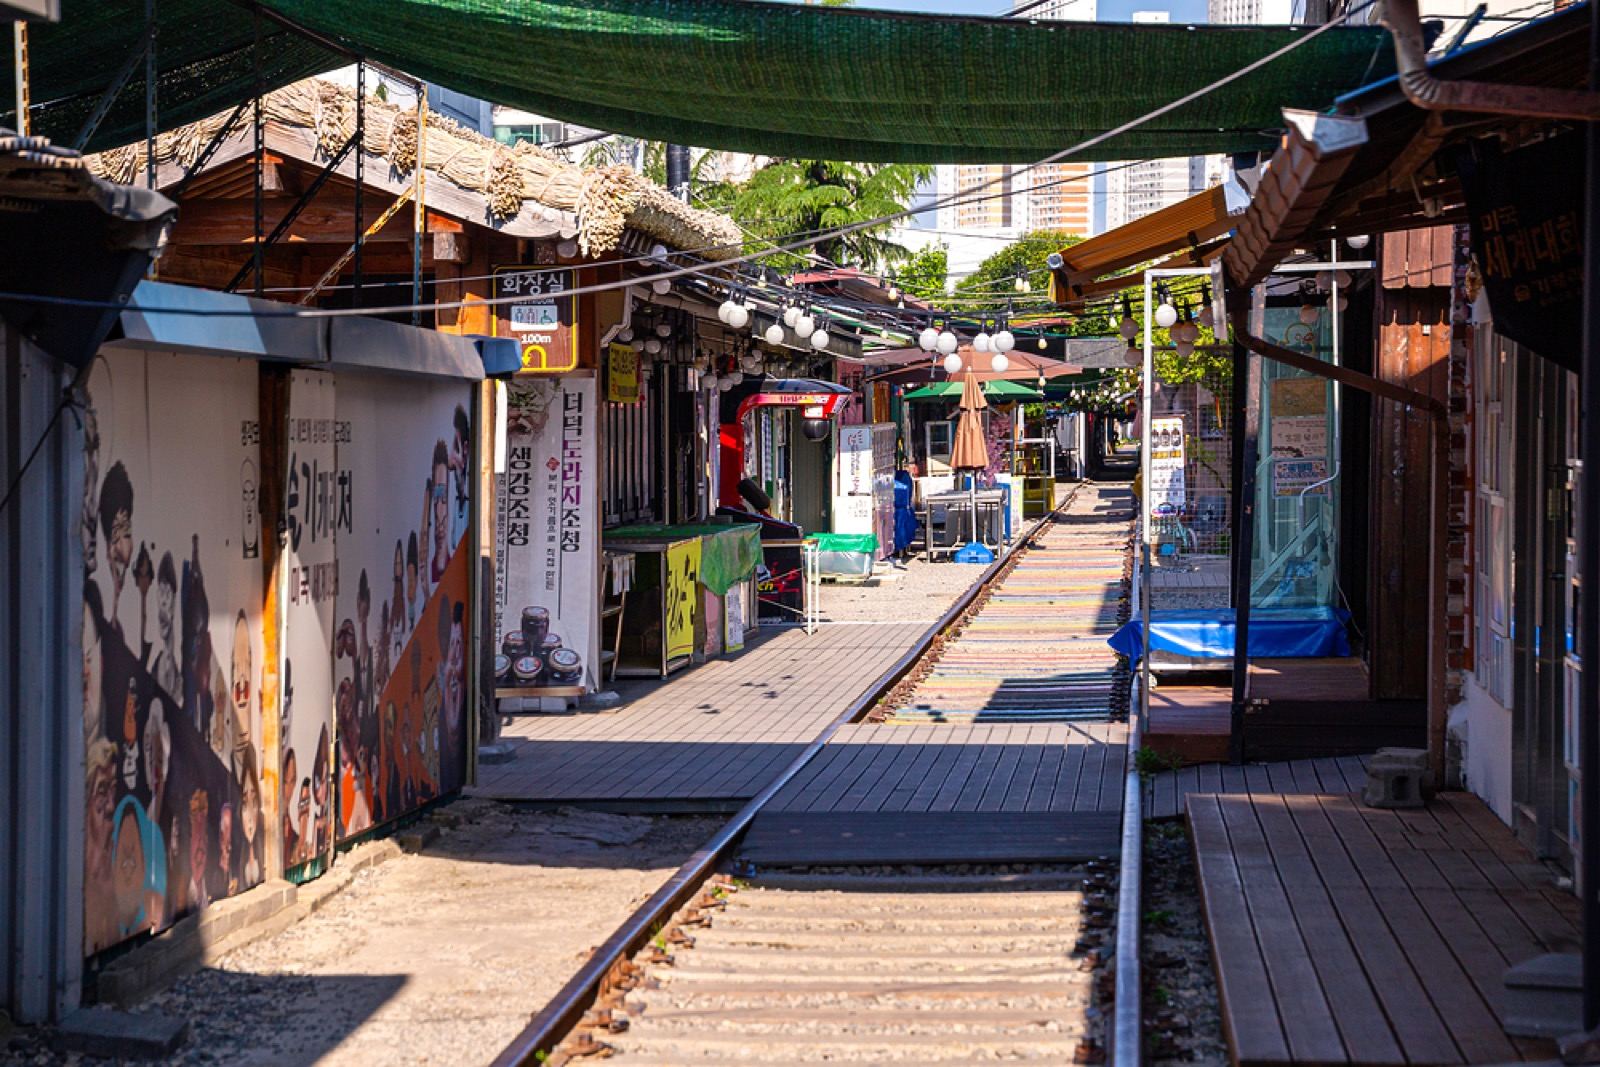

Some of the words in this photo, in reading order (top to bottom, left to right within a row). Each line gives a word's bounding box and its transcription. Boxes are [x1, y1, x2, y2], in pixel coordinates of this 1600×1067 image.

[502, 272, 564, 296] 화장실
[521, 333, 551, 344] 100m
[508, 447, 531, 546] 생강조청
